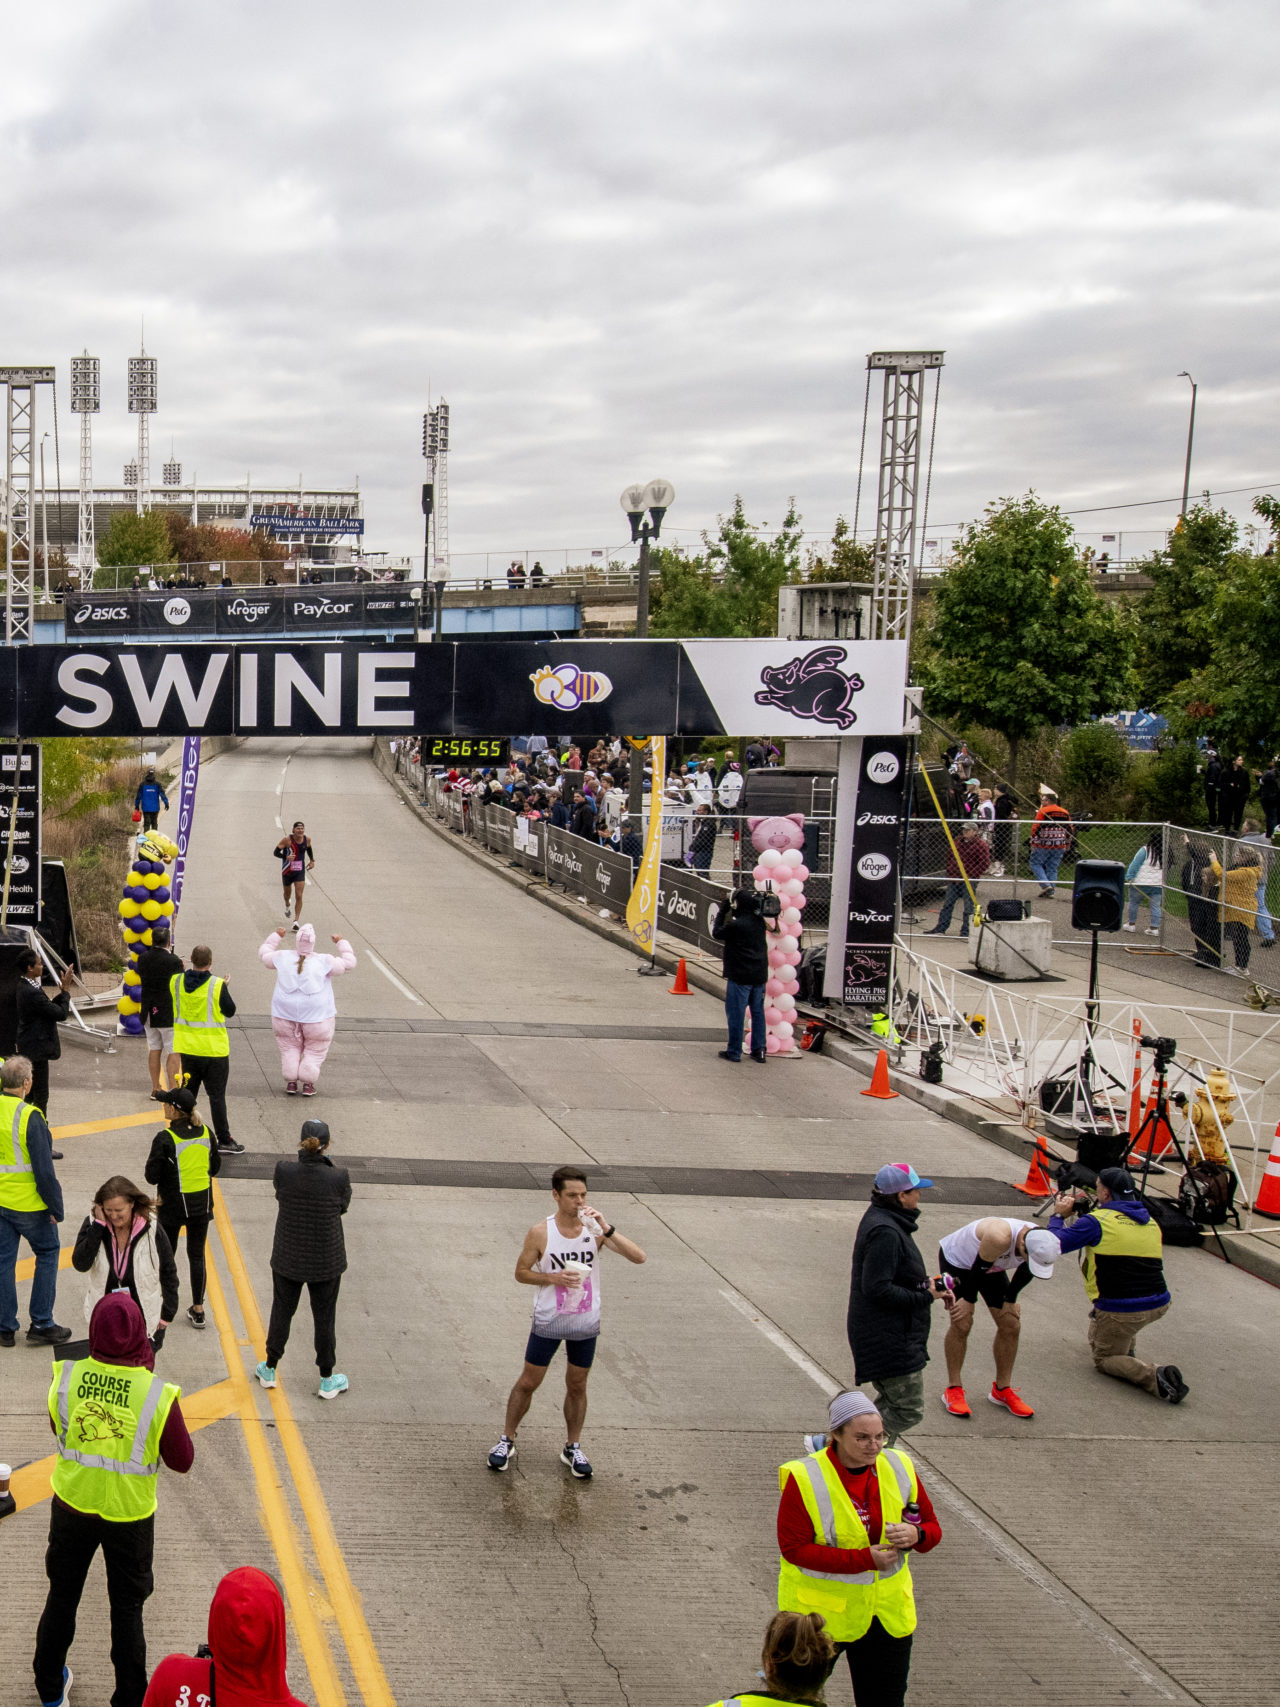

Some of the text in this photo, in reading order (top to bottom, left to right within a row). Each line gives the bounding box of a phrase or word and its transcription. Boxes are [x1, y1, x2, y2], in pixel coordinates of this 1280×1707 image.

[319, 517, 337, 527] BALL
[340, 518, 360, 527] PARK
[169, 606, 187, 616] P&G
[227, 599, 270, 623] Kroger
[293, 602, 354, 618] Paycor
[55, 651, 417, 729] SWINE
[873, 762, 896, 773] P&G
[548, 847, 583, 874] Paycor Paycor
[861, 858, 888, 876] Kroger
[596, 862, 612, 893] Kroger
[9, 884, 33, 893] Health
[849, 912, 893, 923] Paycor
[82, 1371, 132, 1393] COURSE
[77, 1384, 130, 1408] OFFICIAL
